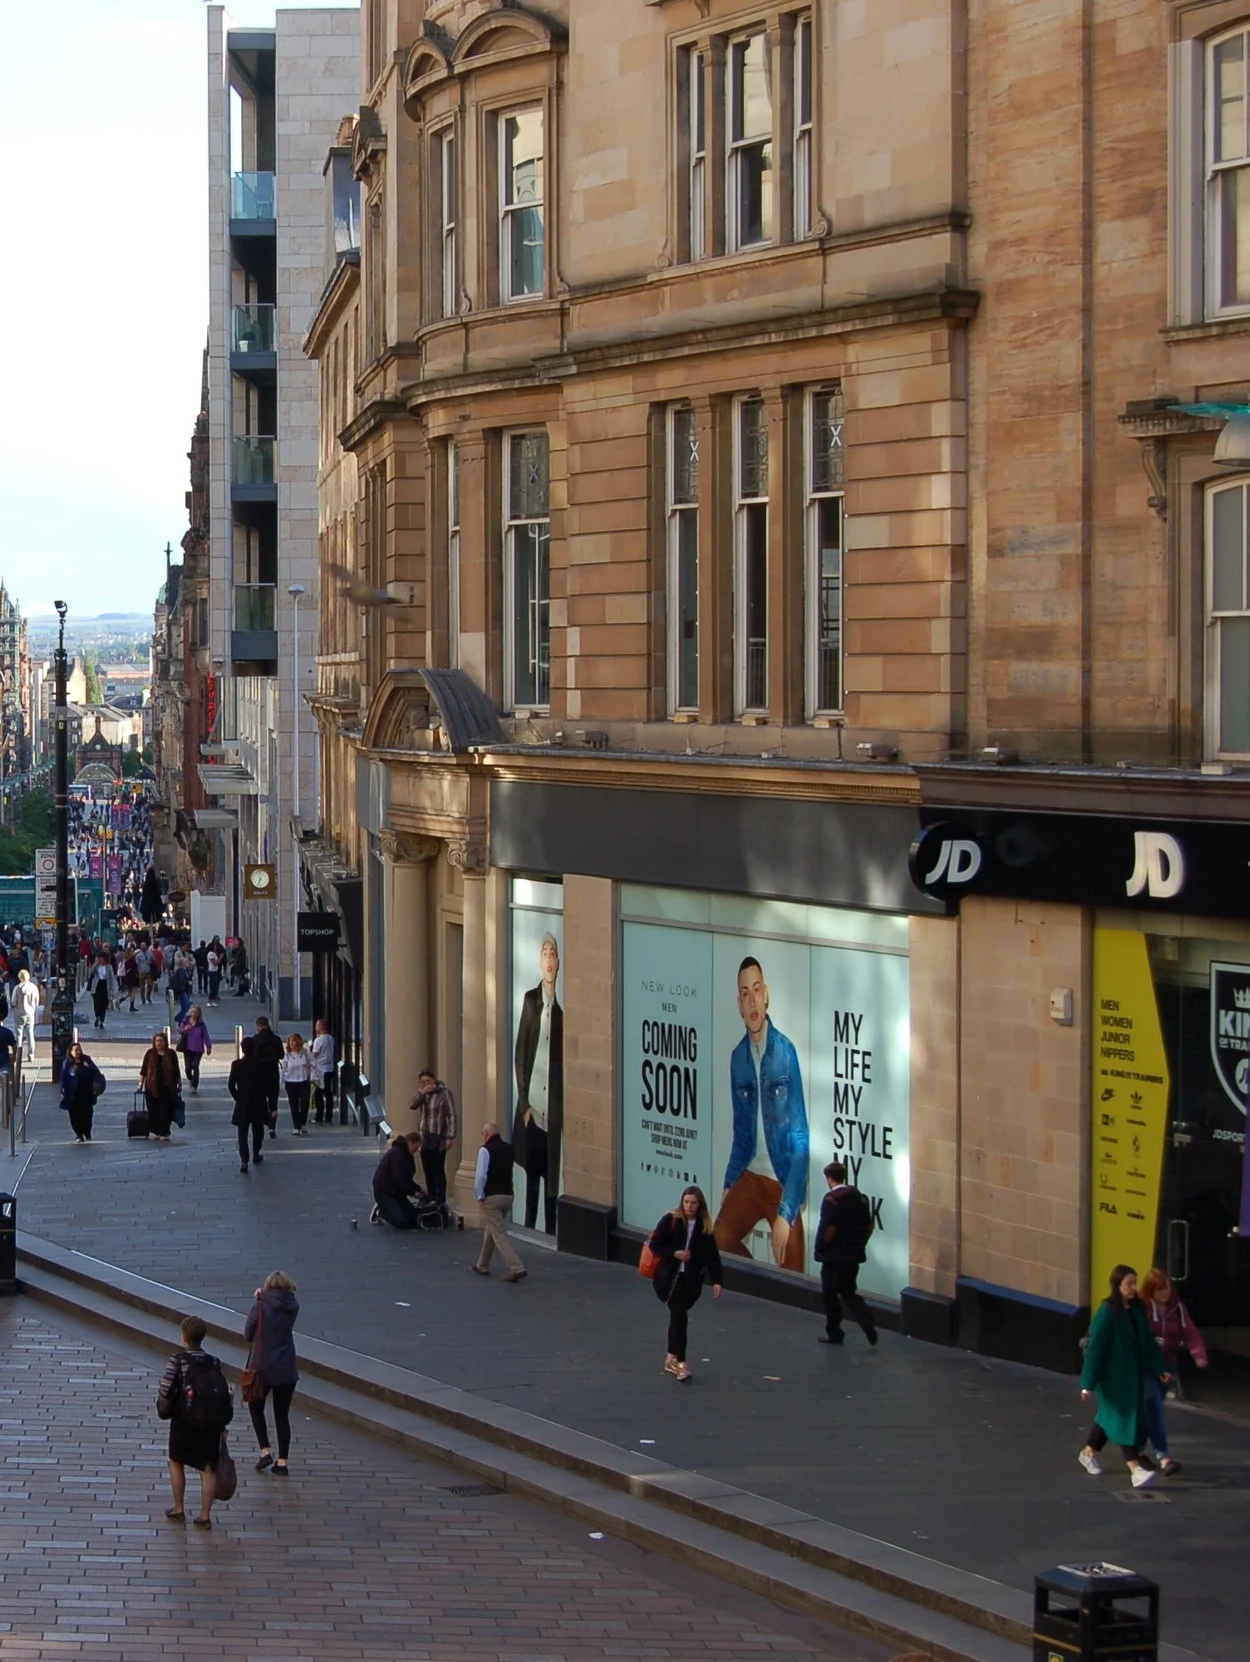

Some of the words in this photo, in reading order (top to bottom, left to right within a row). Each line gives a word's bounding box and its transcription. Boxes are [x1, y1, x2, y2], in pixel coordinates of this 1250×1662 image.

[925, 840, 982, 884] JD
[1125, 831, 1184, 898] JD
[300, 928, 334, 936] TOPSHOP
[641, 980, 664, 993] NEW
[669, 984, 698, 998] LOOK
[661, 1002, 678, 1013] MEN
[1101, 998, 1120, 1011] MEN
[834, 1010, 863, 1046] MY
[1100, 1014, 1133, 1029] WOMEN
[642, 1019, 697, 1062] COMING
[1100, 1031, 1130, 1044] JUNIOR
[834, 1046, 872, 1084] LIFE
[1100, 1046, 1135, 1062] NIPPERS
[642, 1059, 697, 1120] SOON
[833, 1081, 863, 1117] MY
[833, 1116, 893, 1160] STYLE
[1100, 1202, 1117, 1215] FILA
